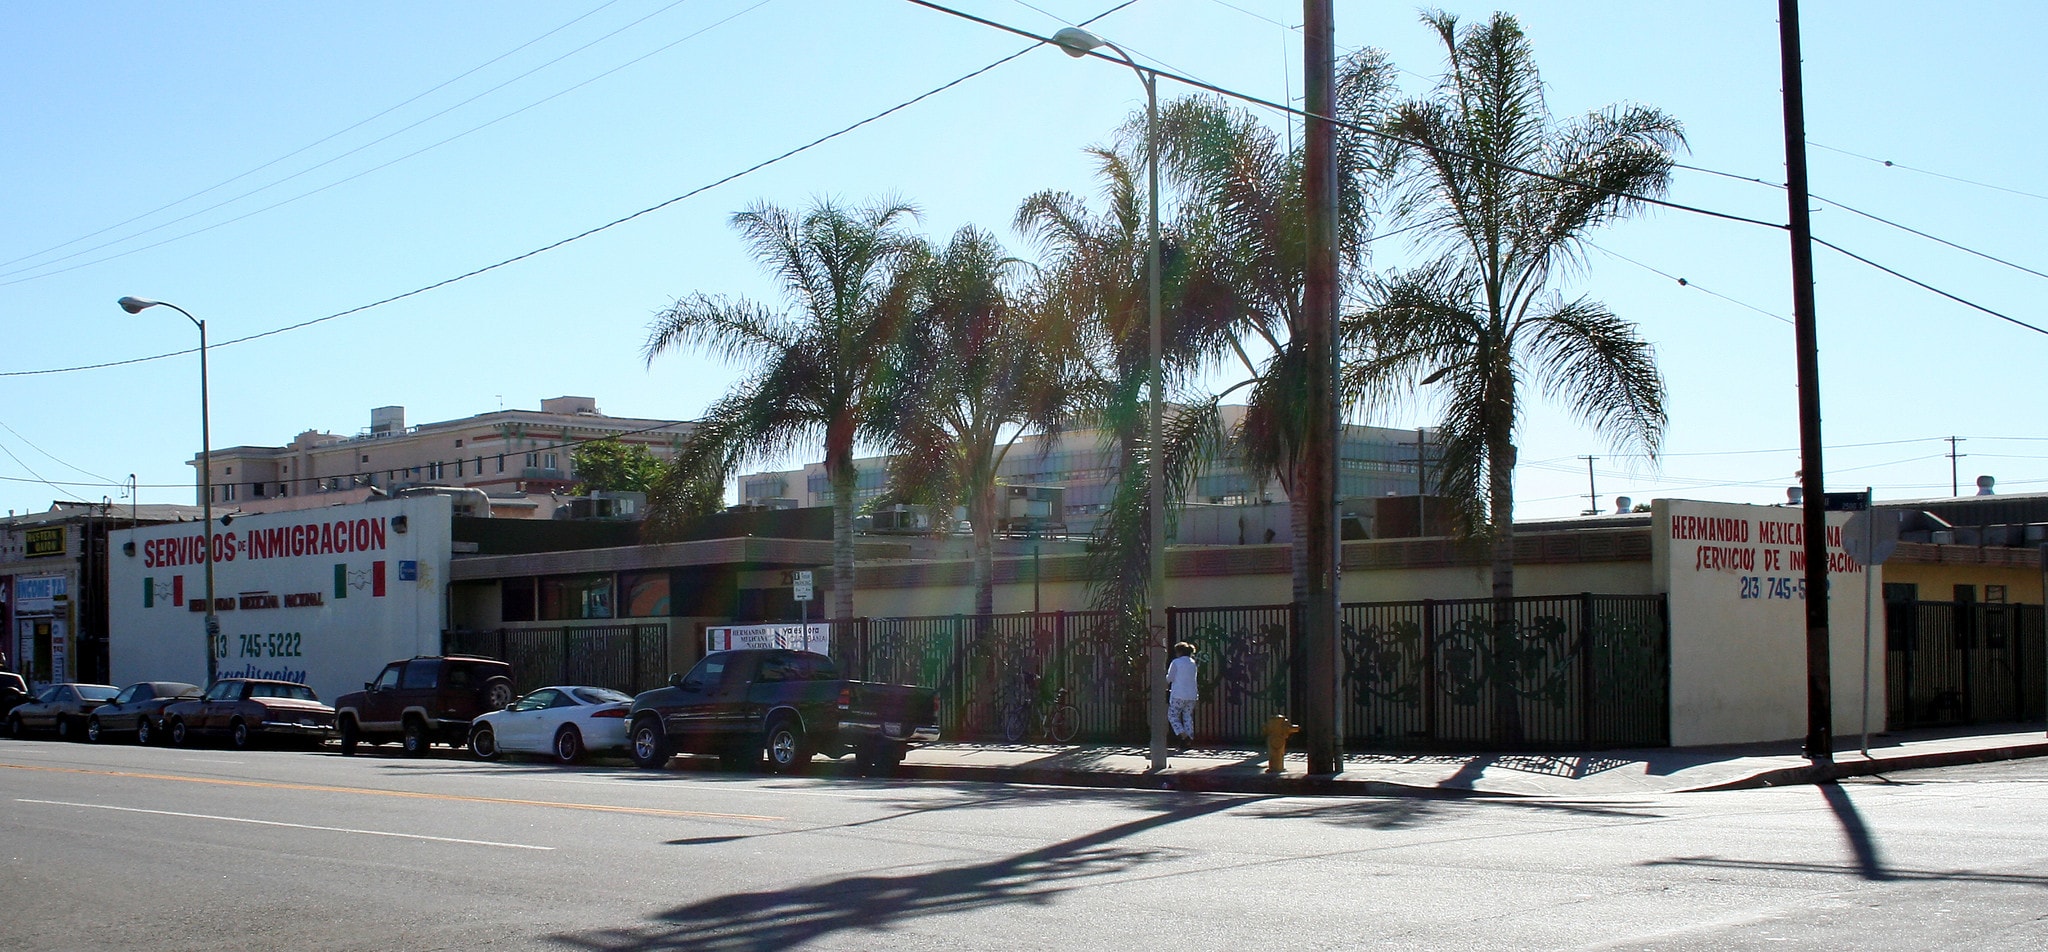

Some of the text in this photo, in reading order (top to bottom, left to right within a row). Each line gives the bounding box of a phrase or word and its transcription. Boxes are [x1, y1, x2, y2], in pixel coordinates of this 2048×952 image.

[144, 517, 386, 569] SERVICOS DE INMIGRACION
[1672, 515, 1749, 543] HERMANDAD
[1760, 520, 1806, 546] MEXICA
[1696, 545, 1755, 572] SERVICIOS
[1764, 548, 1780, 572] DE
[1740, 576, 1830, 600] 213 745-5
[215, 632, 302, 658] 13 745-5222
